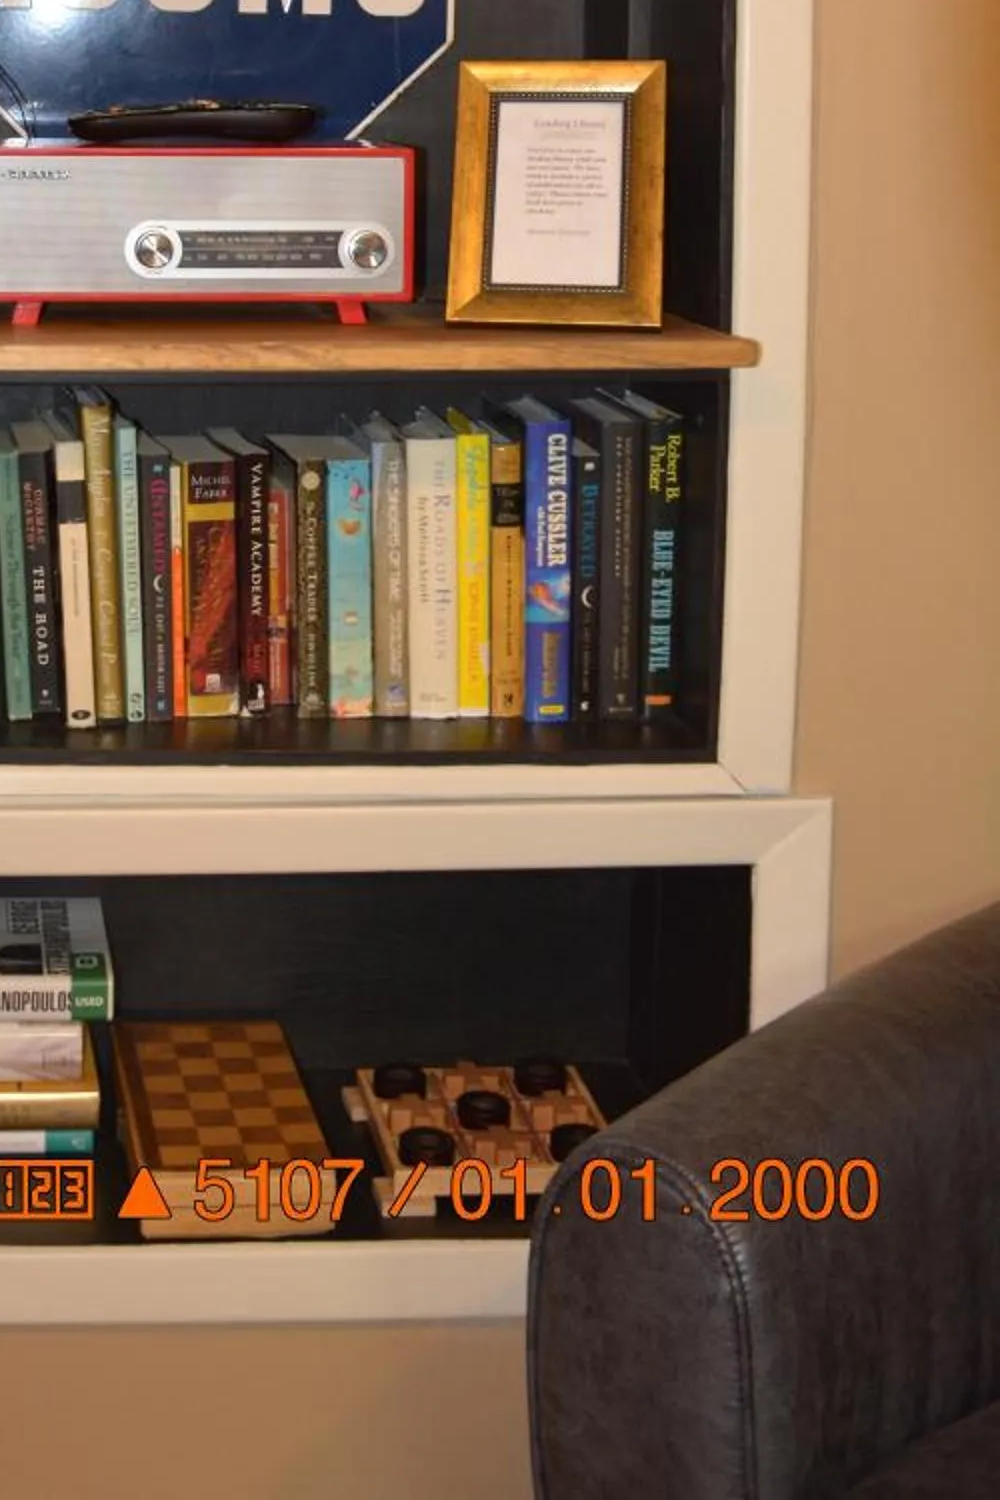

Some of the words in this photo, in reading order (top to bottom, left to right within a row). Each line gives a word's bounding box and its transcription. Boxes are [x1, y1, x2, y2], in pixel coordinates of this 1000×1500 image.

[121, 451, 134, 479] THE
[547, 433, 568, 485] CLIVE
[648, 444, 665, 492] Parker
[665, 434, 681, 484] Robert
[250, 463, 264, 533] VAMPIRE
[665, 486, 680, 502] B.
[123, 486, 139, 591] UNTETHERED
[433, 494, 450, 555] ROADS
[547, 489, 568, 566] CUSSLER
[31, 565, 46, 602] THE
[250, 540, 264, 616] ACADEMY
[650, 529, 675, 618] BLUE-EYED
[35, 611, 49, 665] ROAD
[126, 597, 140, 633] SOUL
[435, 587, 452, 660] HEAVEN
[648, 624, 671, 671] DEVIL
[74, 996, 103, 1008] USED
